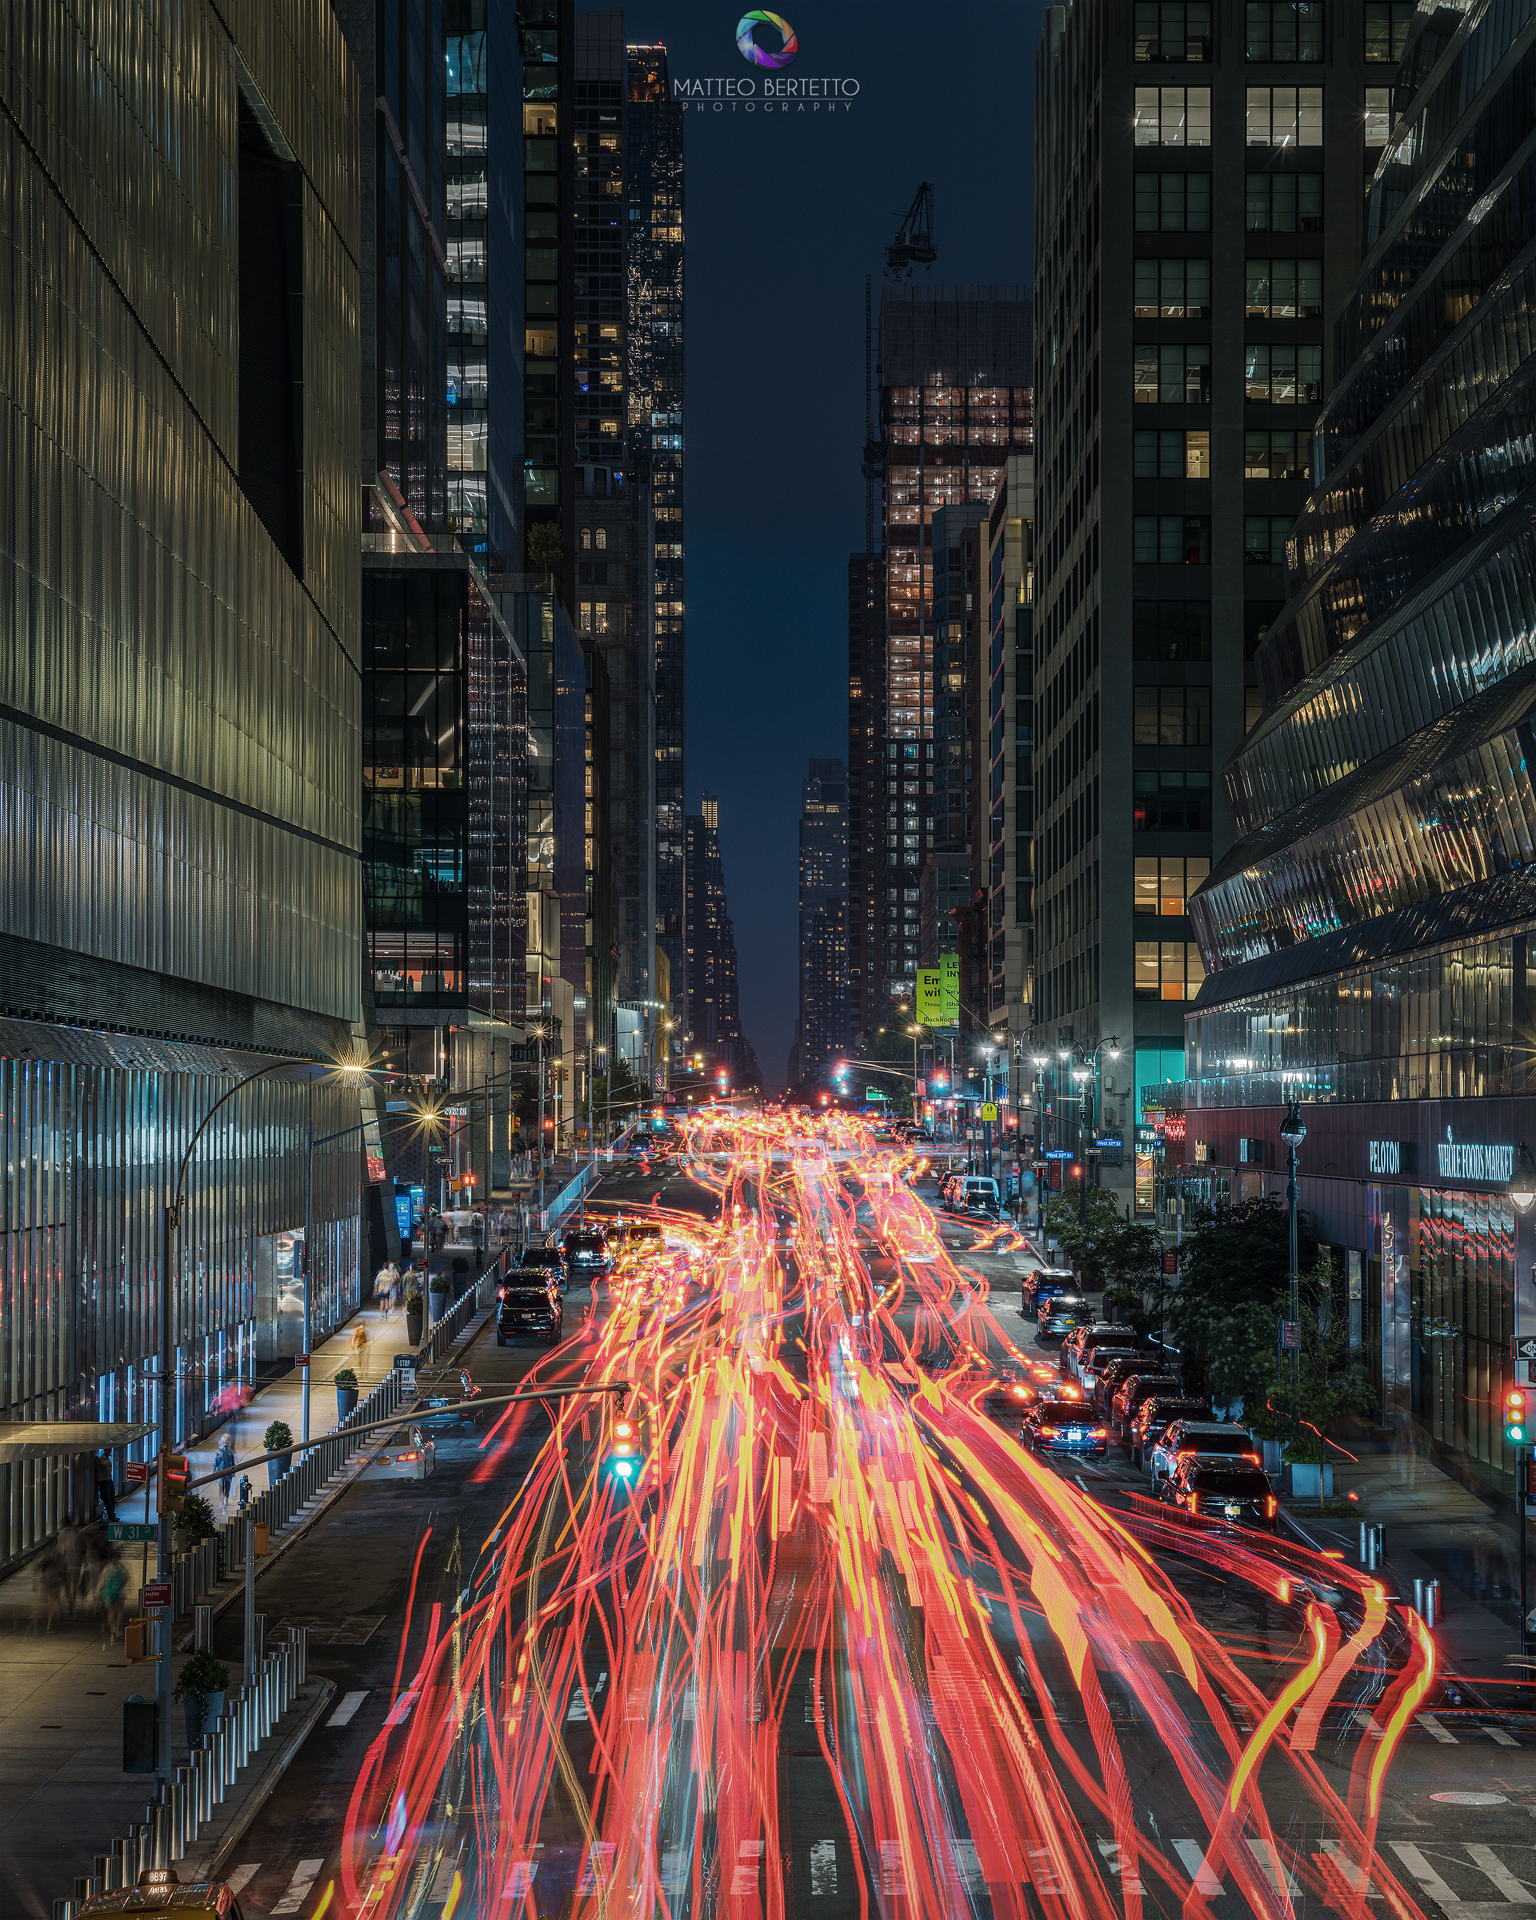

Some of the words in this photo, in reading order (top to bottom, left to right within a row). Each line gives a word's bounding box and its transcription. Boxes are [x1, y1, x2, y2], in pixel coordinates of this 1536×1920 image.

[1369, 1141, 1400, 1174] PELOTON
[1438, 1144, 1461, 1178] WHOLE
[1461, 1144, 1484, 1180] FOODS
[1485, 1145, 1514, 1181] MARKET
[113, 1526, 123, 1539] W
[128, 1526, 139, 1539] 31
[144, 1526, 151, 1534] ST
[149, 1872, 167, 1882] 8B97
